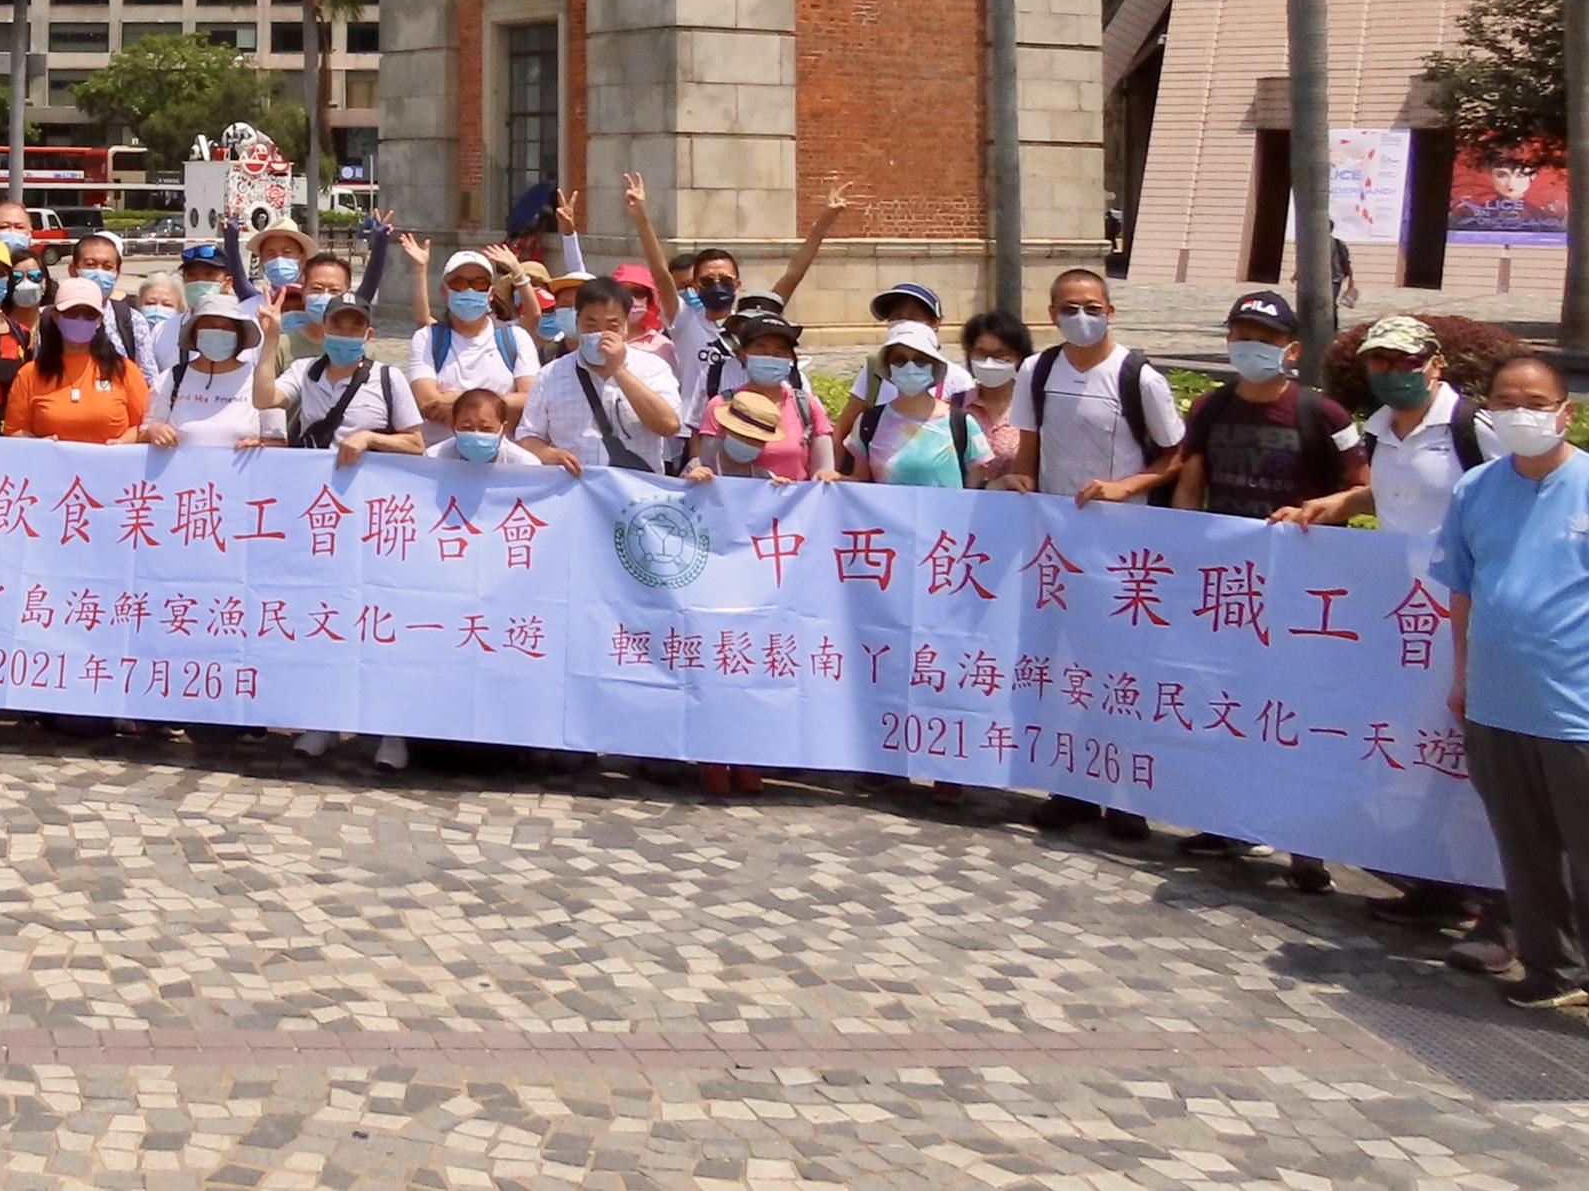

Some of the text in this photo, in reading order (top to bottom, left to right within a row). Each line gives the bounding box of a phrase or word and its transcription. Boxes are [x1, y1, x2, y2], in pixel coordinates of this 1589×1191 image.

[1240, 298, 1278, 316] FILA
[750, 518, 1451, 670] 中西飲食業職工會
[608, 623, 1469, 780] 輕輕鬆鬆南丫島海鮮宴漁民文化一天遊
[881, 712, 1155, 789] 2021年7月26日
